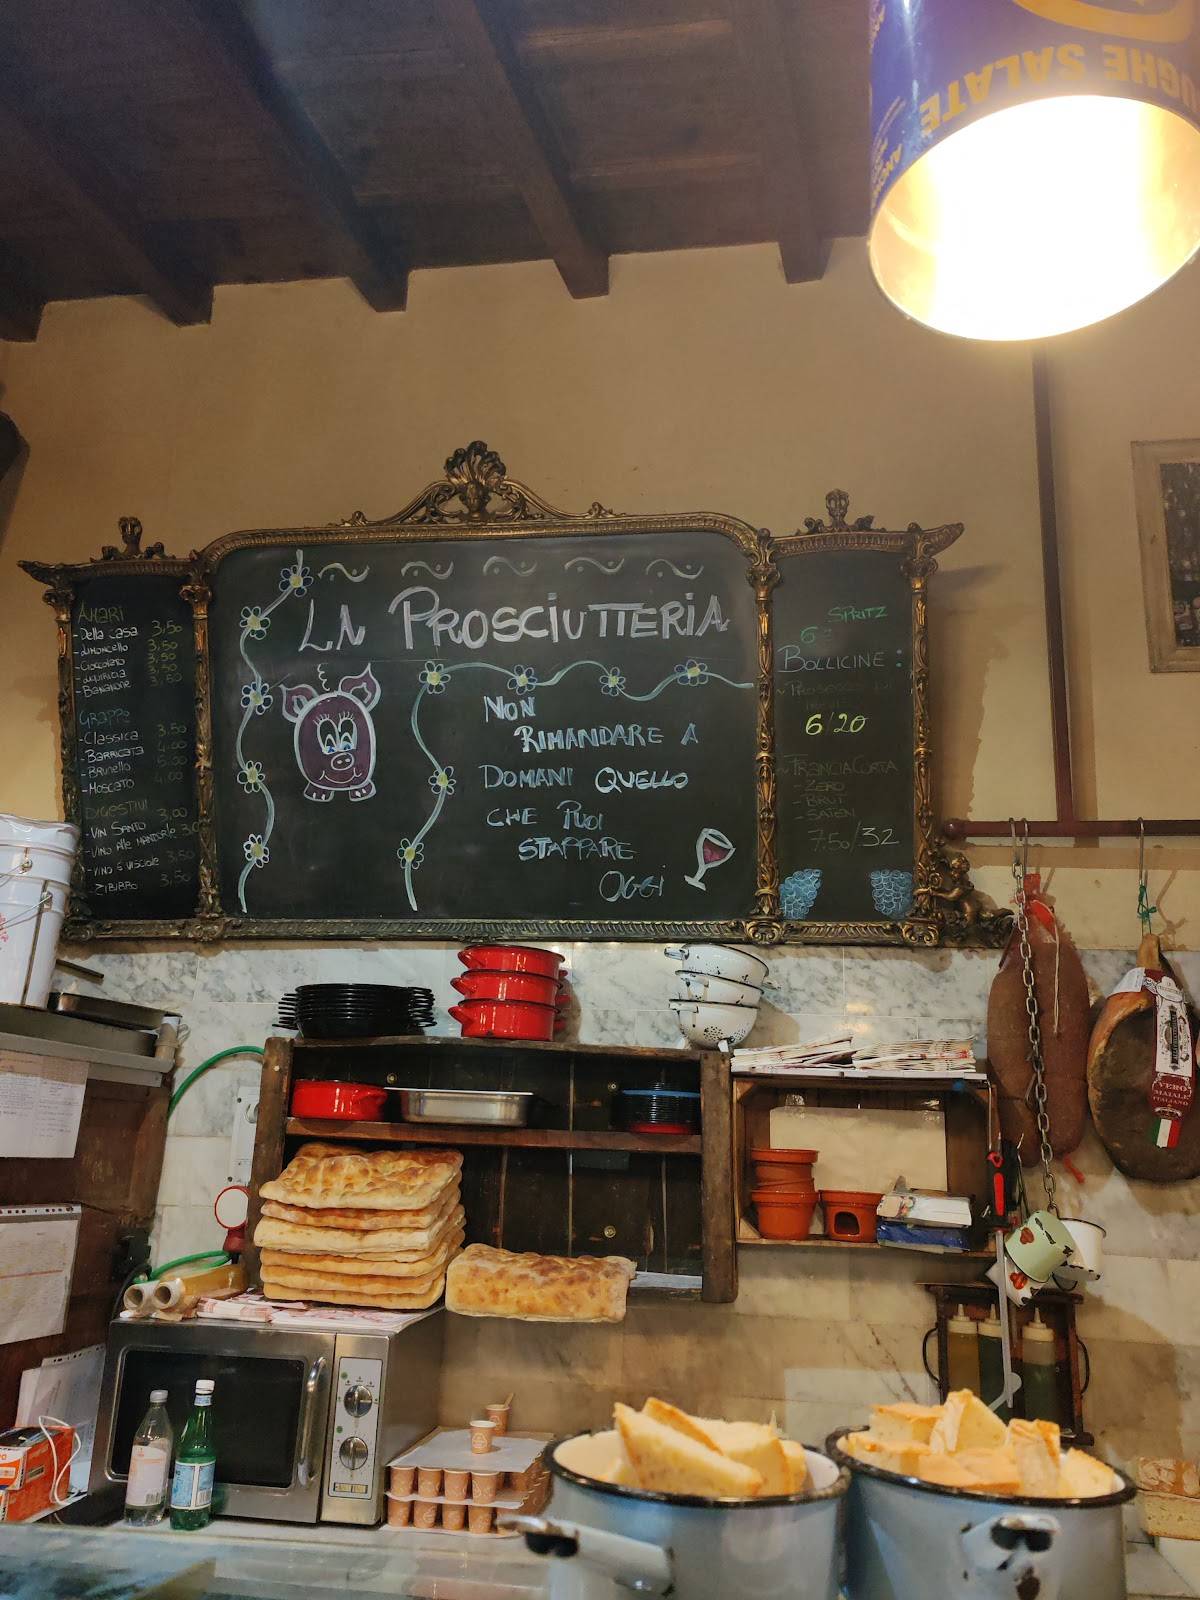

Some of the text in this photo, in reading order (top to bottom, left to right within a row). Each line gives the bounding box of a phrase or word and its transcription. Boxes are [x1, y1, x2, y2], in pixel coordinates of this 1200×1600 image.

[919, 43, 1086, 138] SALATE
[298, 585, 730, 651] LA PROSCIUTTERIA
[777, 644, 885, 674] BOLLICINE
[483, 695, 537, 723] NON
[513, 723, 699, 754] RIMANDARE A
[478, 764, 689, 794] DOMANI QUELLO
[486, 800, 604, 831] CHE PUOI
[518, 836, 638, 862] STAPPARE
[1153, 1089, 1190, 1100] MAIALE
[1158, 1080, 1188, 1093] VERO
